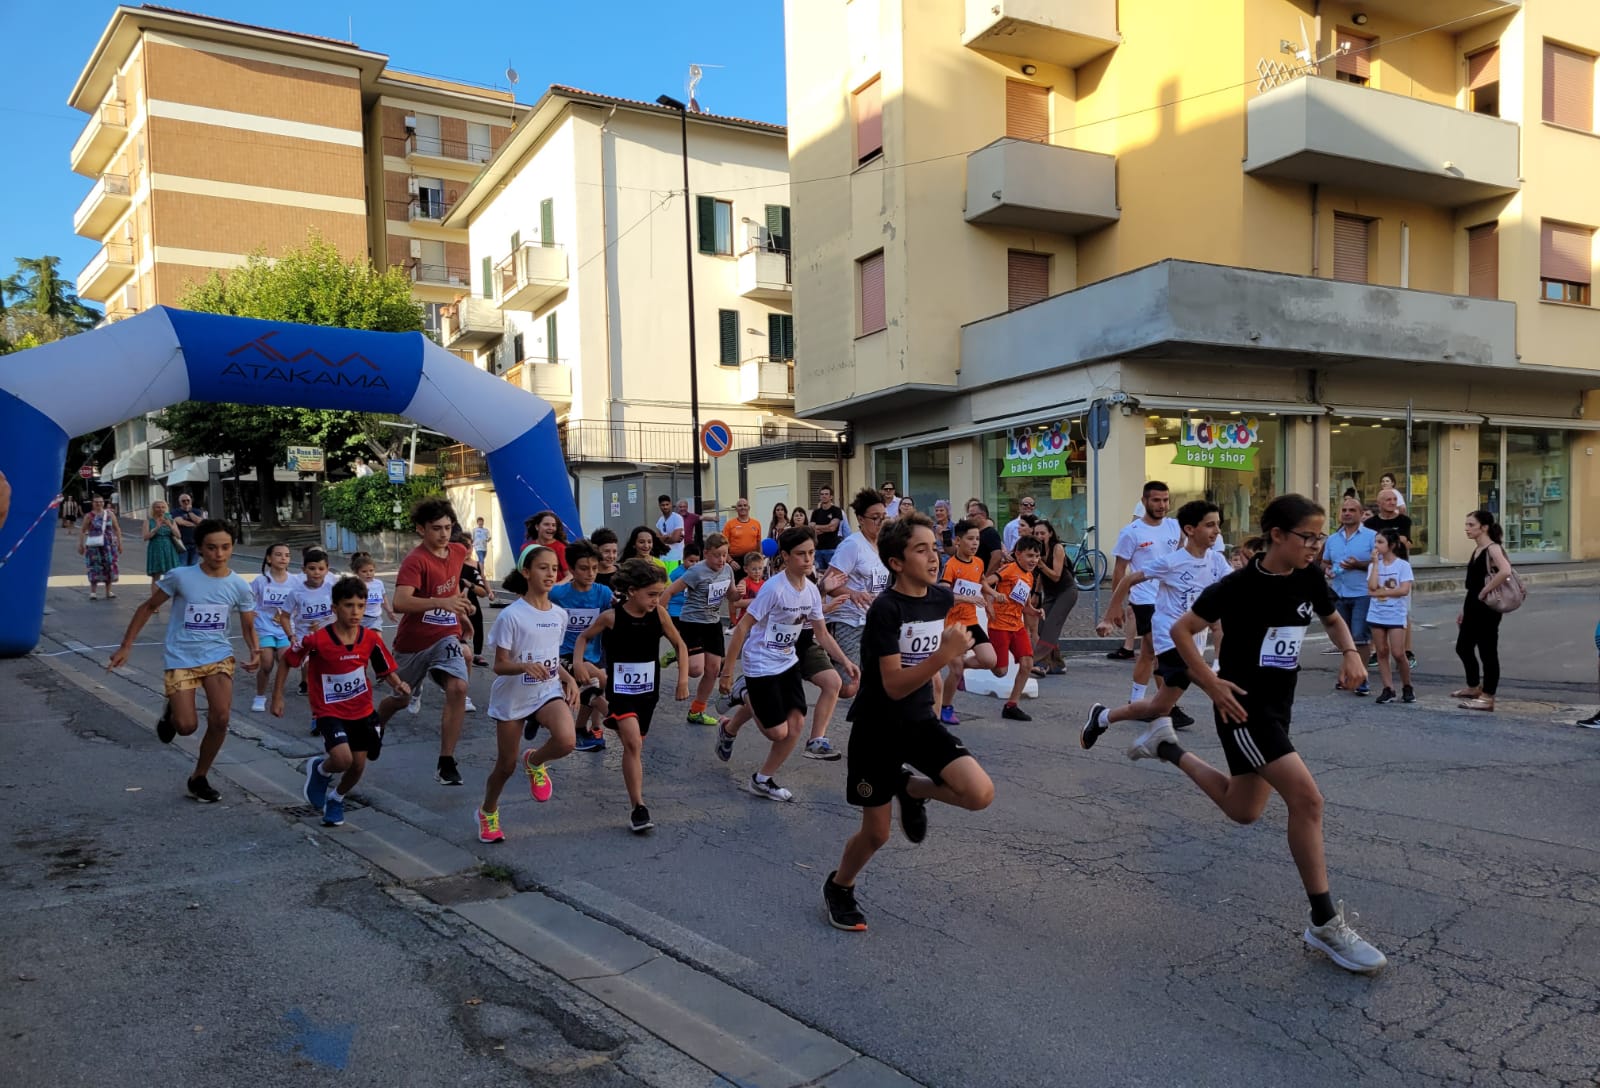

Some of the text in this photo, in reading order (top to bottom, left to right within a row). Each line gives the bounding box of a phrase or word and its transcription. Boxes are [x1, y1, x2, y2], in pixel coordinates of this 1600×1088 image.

[220, 362, 390, 390] ATAKAMA
[1187, 450, 1246, 464] baby shop
[1011, 460, 1060, 473] baby shop
[960, 586, 977, 596] 009
[306, 603, 328, 613] 078
[193, 612, 221, 623] 025
[570, 615, 593, 625] 057
[911, 635, 939, 653] 029
[543, 657, 558, 669] 93
[623, 672, 649, 684] 021
[333, 677, 361, 693] 089
